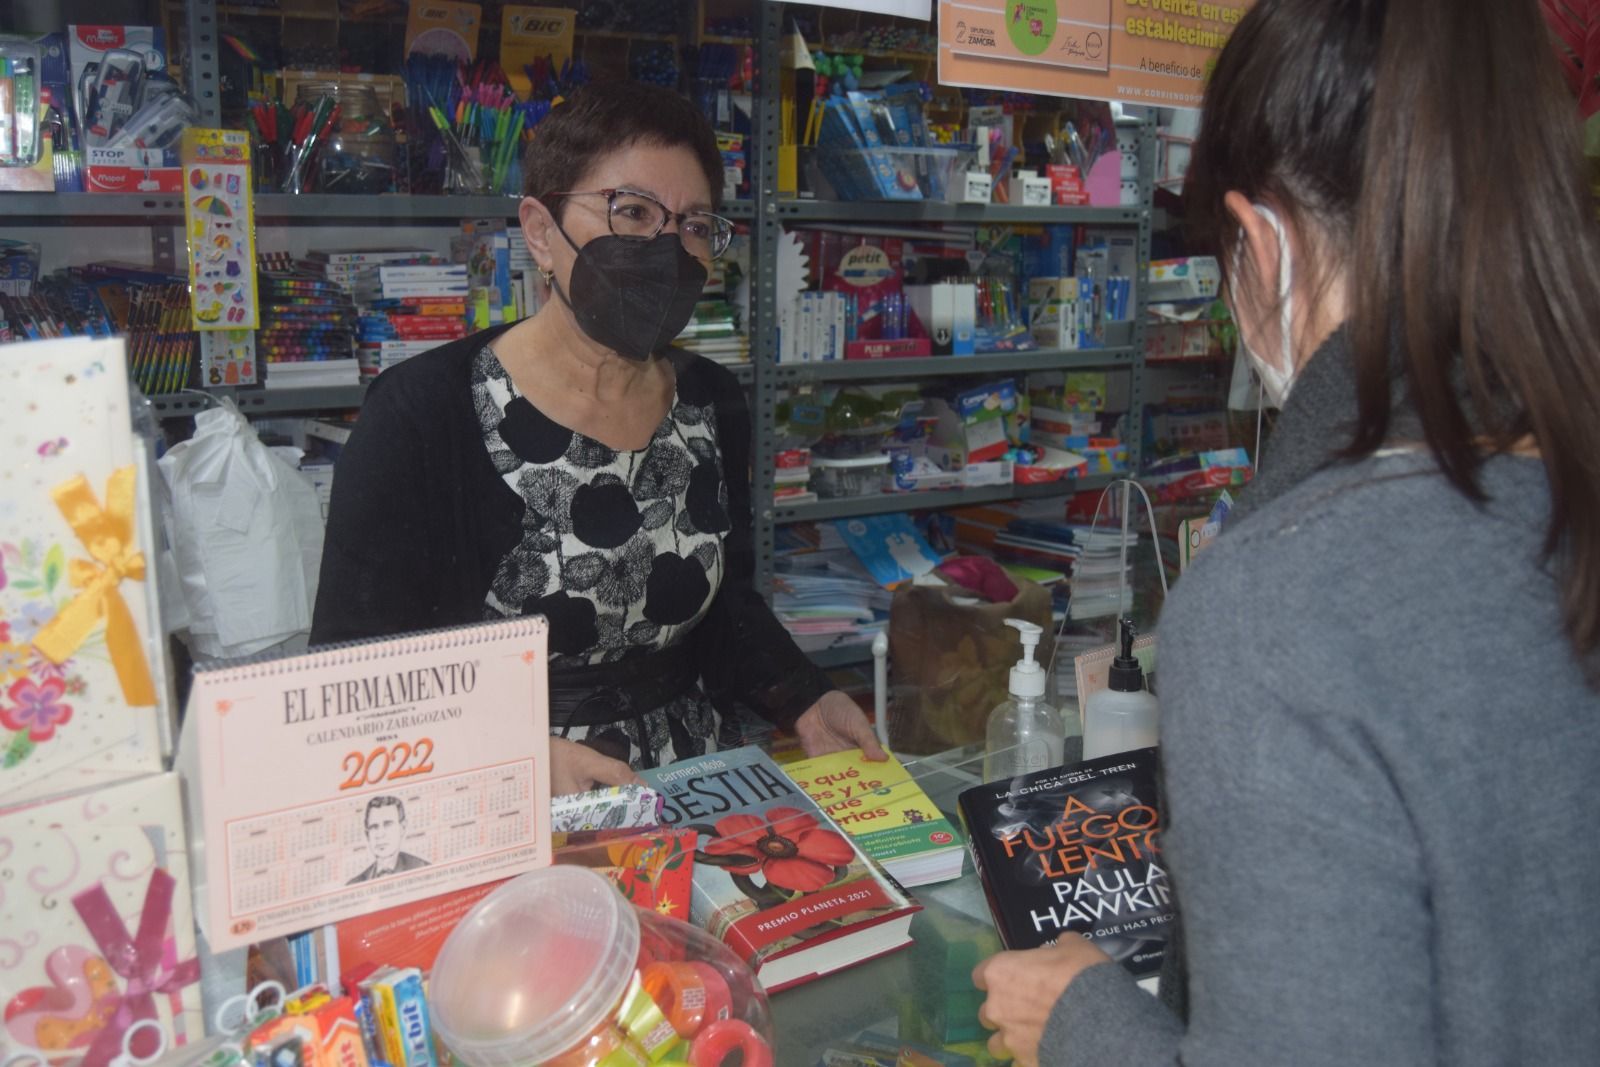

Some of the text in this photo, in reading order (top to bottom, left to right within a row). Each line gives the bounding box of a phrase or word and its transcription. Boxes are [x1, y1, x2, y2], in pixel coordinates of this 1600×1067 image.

[525, 19, 562, 33] BIC
[1140, 56, 1201, 78] A beneficio de
[92, 150, 124, 158] STOP
[848, 252, 881, 265] petit
[282, 660, 477, 725] EL FIRMAMENTO
[306, 722, 384, 746] CALENDARIO
[386, 706, 462, 733] ZARAGOZANO
[338, 737, 435, 790] 2022
[657, 760, 726, 783] Carmen Mola
[814, 766, 860, 786] qué
[858, 779, 883, 791] te
[995, 763, 1136, 799] LA CHICA DEL TREN
[1062, 795, 1096, 820] A
[1002, 805, 1159, 858] FUEGO
[1052, 862, 1169, 904] PAULA
[757, 889, 872, 932] PREMIO PLANETA 2021
[1030, 884, 1171, 932] HAWKIN
[1096, 926, 1121, 937] QUE
[1123, 920, 1148, 931] HAS
[1150, 913, 1176, 925] PRO
